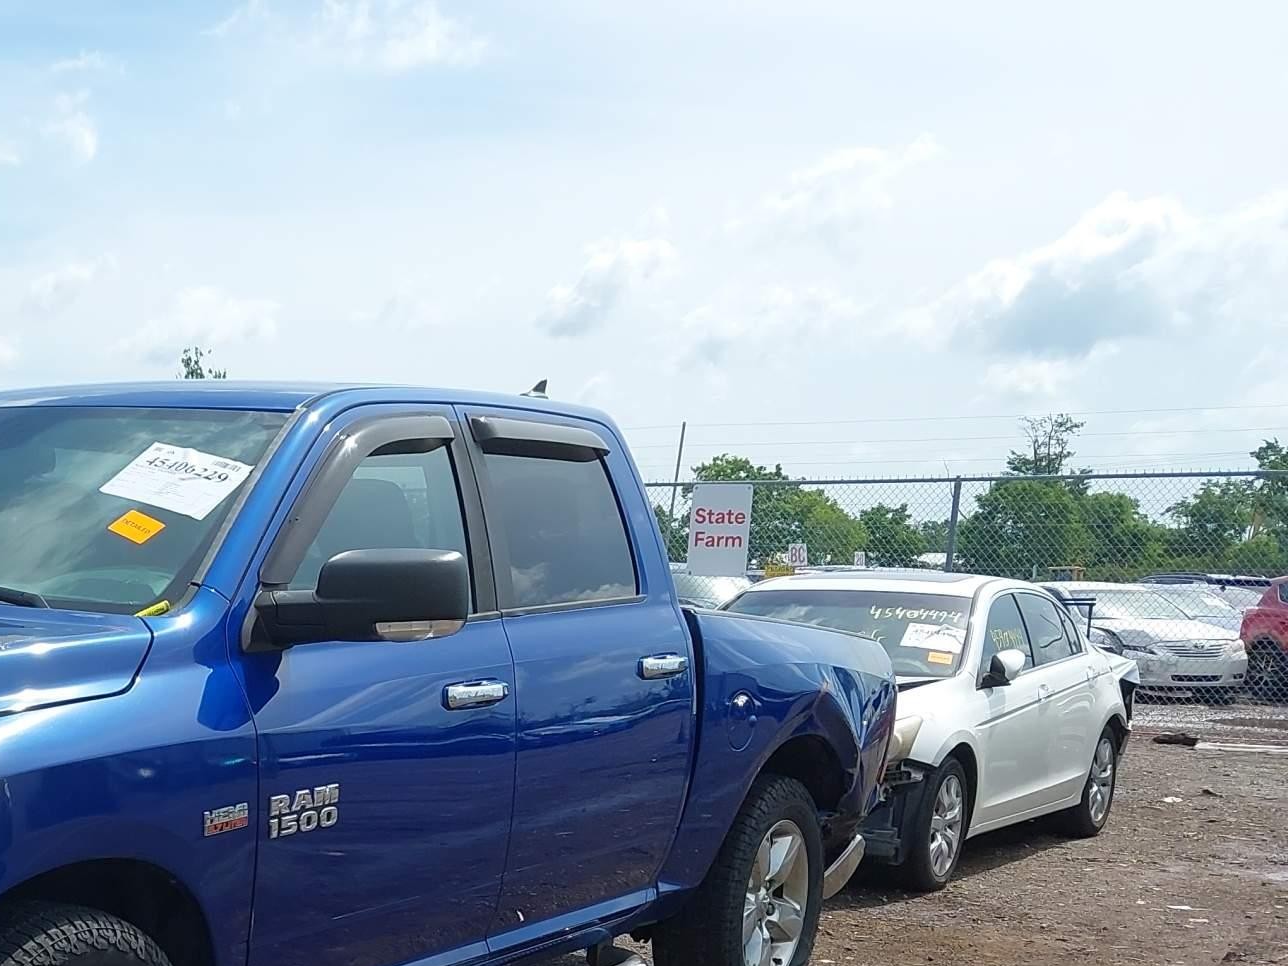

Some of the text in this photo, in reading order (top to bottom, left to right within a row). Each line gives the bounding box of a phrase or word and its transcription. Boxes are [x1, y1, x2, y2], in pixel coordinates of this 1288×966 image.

[145, 456, 230, 483] 45406229
[694, 507, 746, 525] State
[694, 531, 743, 548] Farm
[790, 546, 806, 564] BC
[269, 783, 340, 818] RAM
[269, 806, 339, 840] 1500
